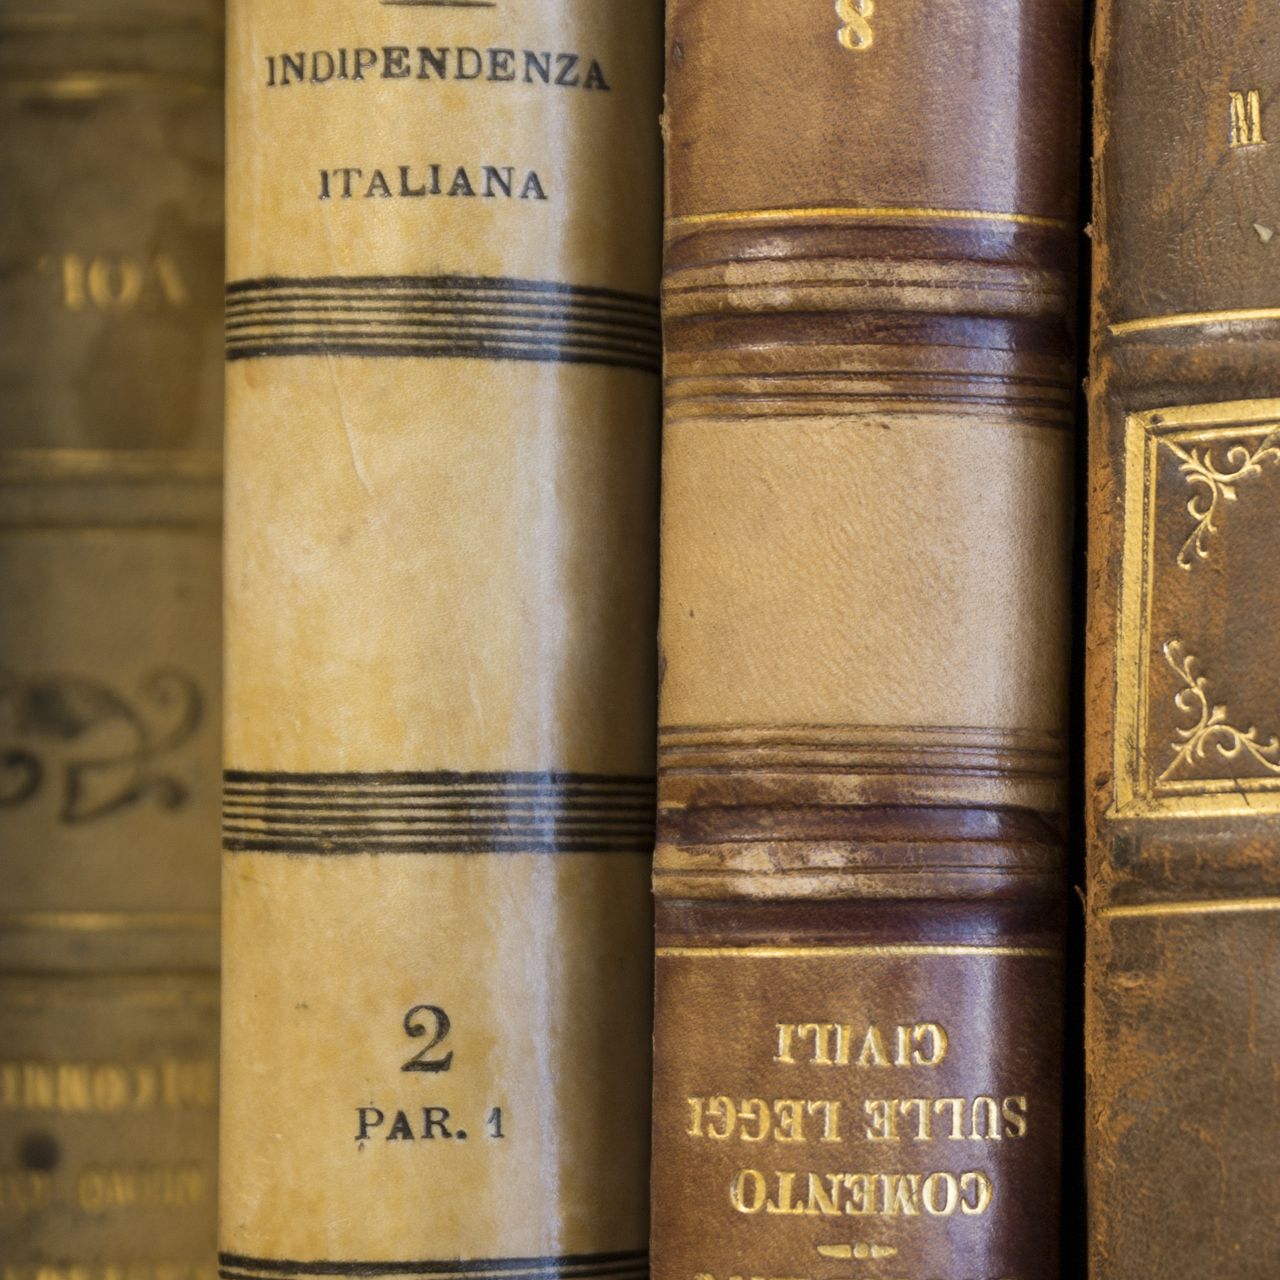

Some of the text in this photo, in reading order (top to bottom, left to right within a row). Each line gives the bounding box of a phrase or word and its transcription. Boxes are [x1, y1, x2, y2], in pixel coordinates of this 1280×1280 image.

[265, 46, 611, 91] INDIPENDENZA
[318, 164, 548, 200] ITALIANA
[400, 1004, 454, 1073] 2
[773, 1021, 948, 1067] CIVILI
[354, 1106, 504, 1141] PAR. 1
[686, 1095, 1028, 1142] SULLE LEGGI
[729, 1168, 993, 1216] COMENTO
